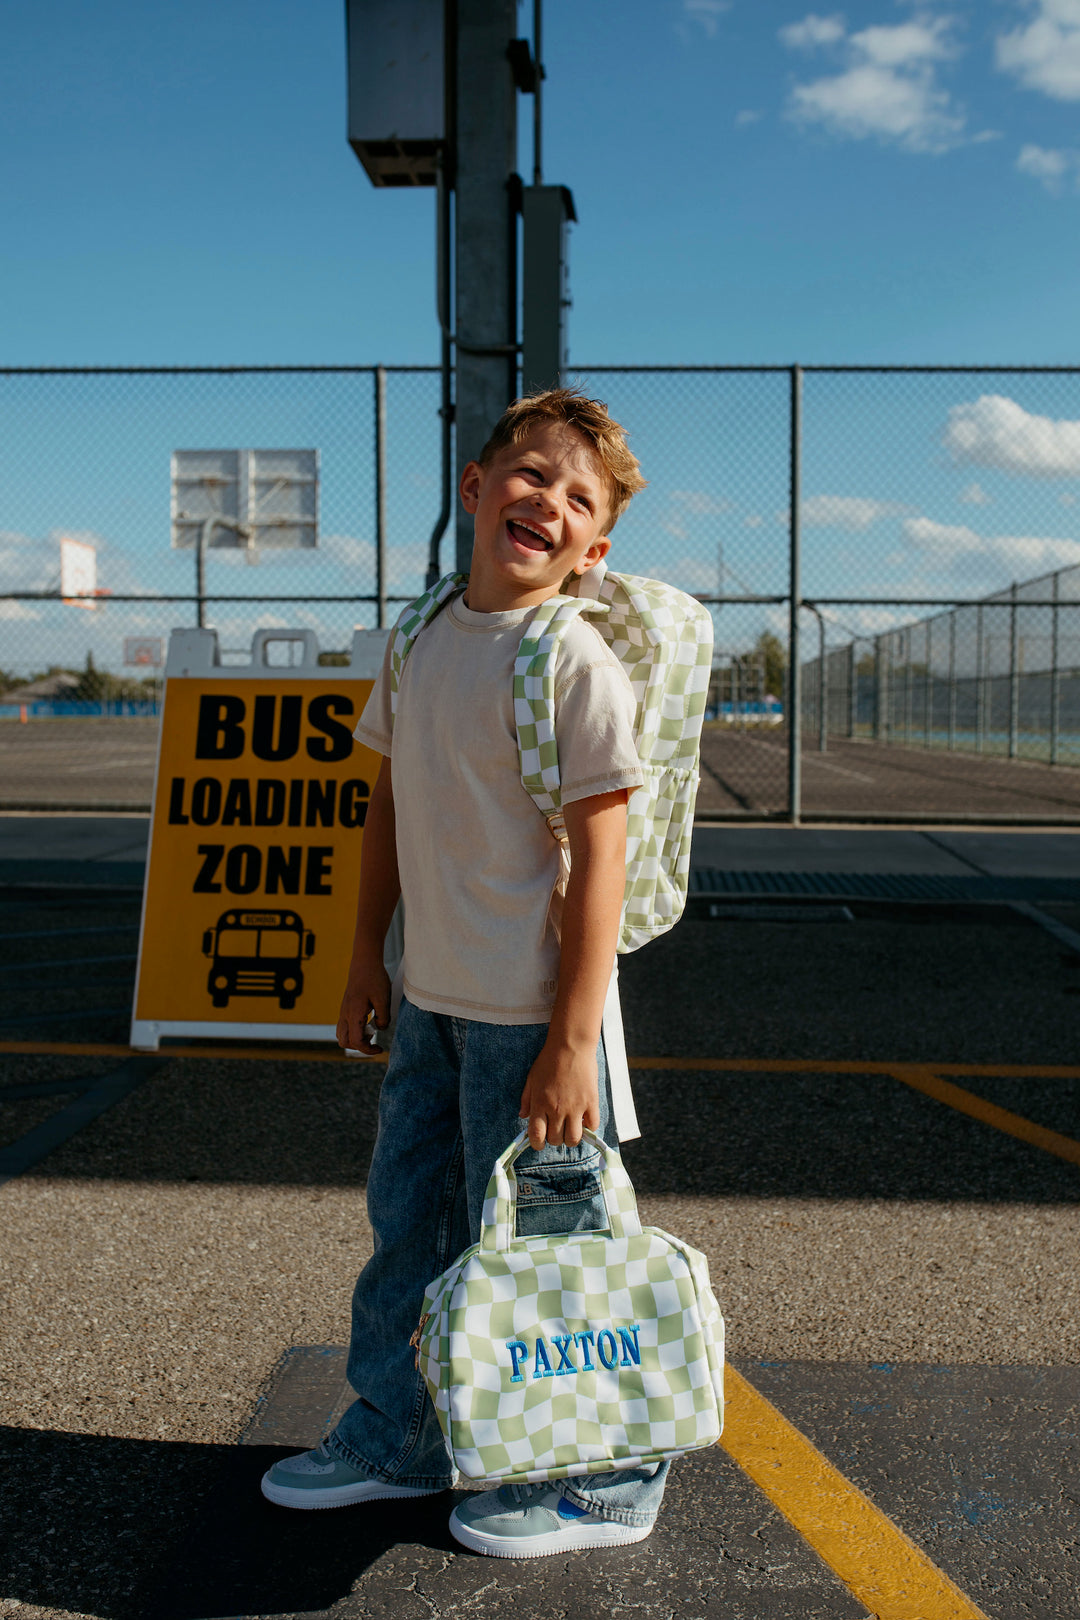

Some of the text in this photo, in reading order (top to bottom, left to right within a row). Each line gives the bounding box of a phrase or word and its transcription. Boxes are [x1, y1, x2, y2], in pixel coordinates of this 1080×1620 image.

[195, 694, 354, 762] BUS
[168, 777, 370, 828] LOADING
[193, 845, 334, 895] ZONE
[506, 1324, 641, 1382] PAXTON
